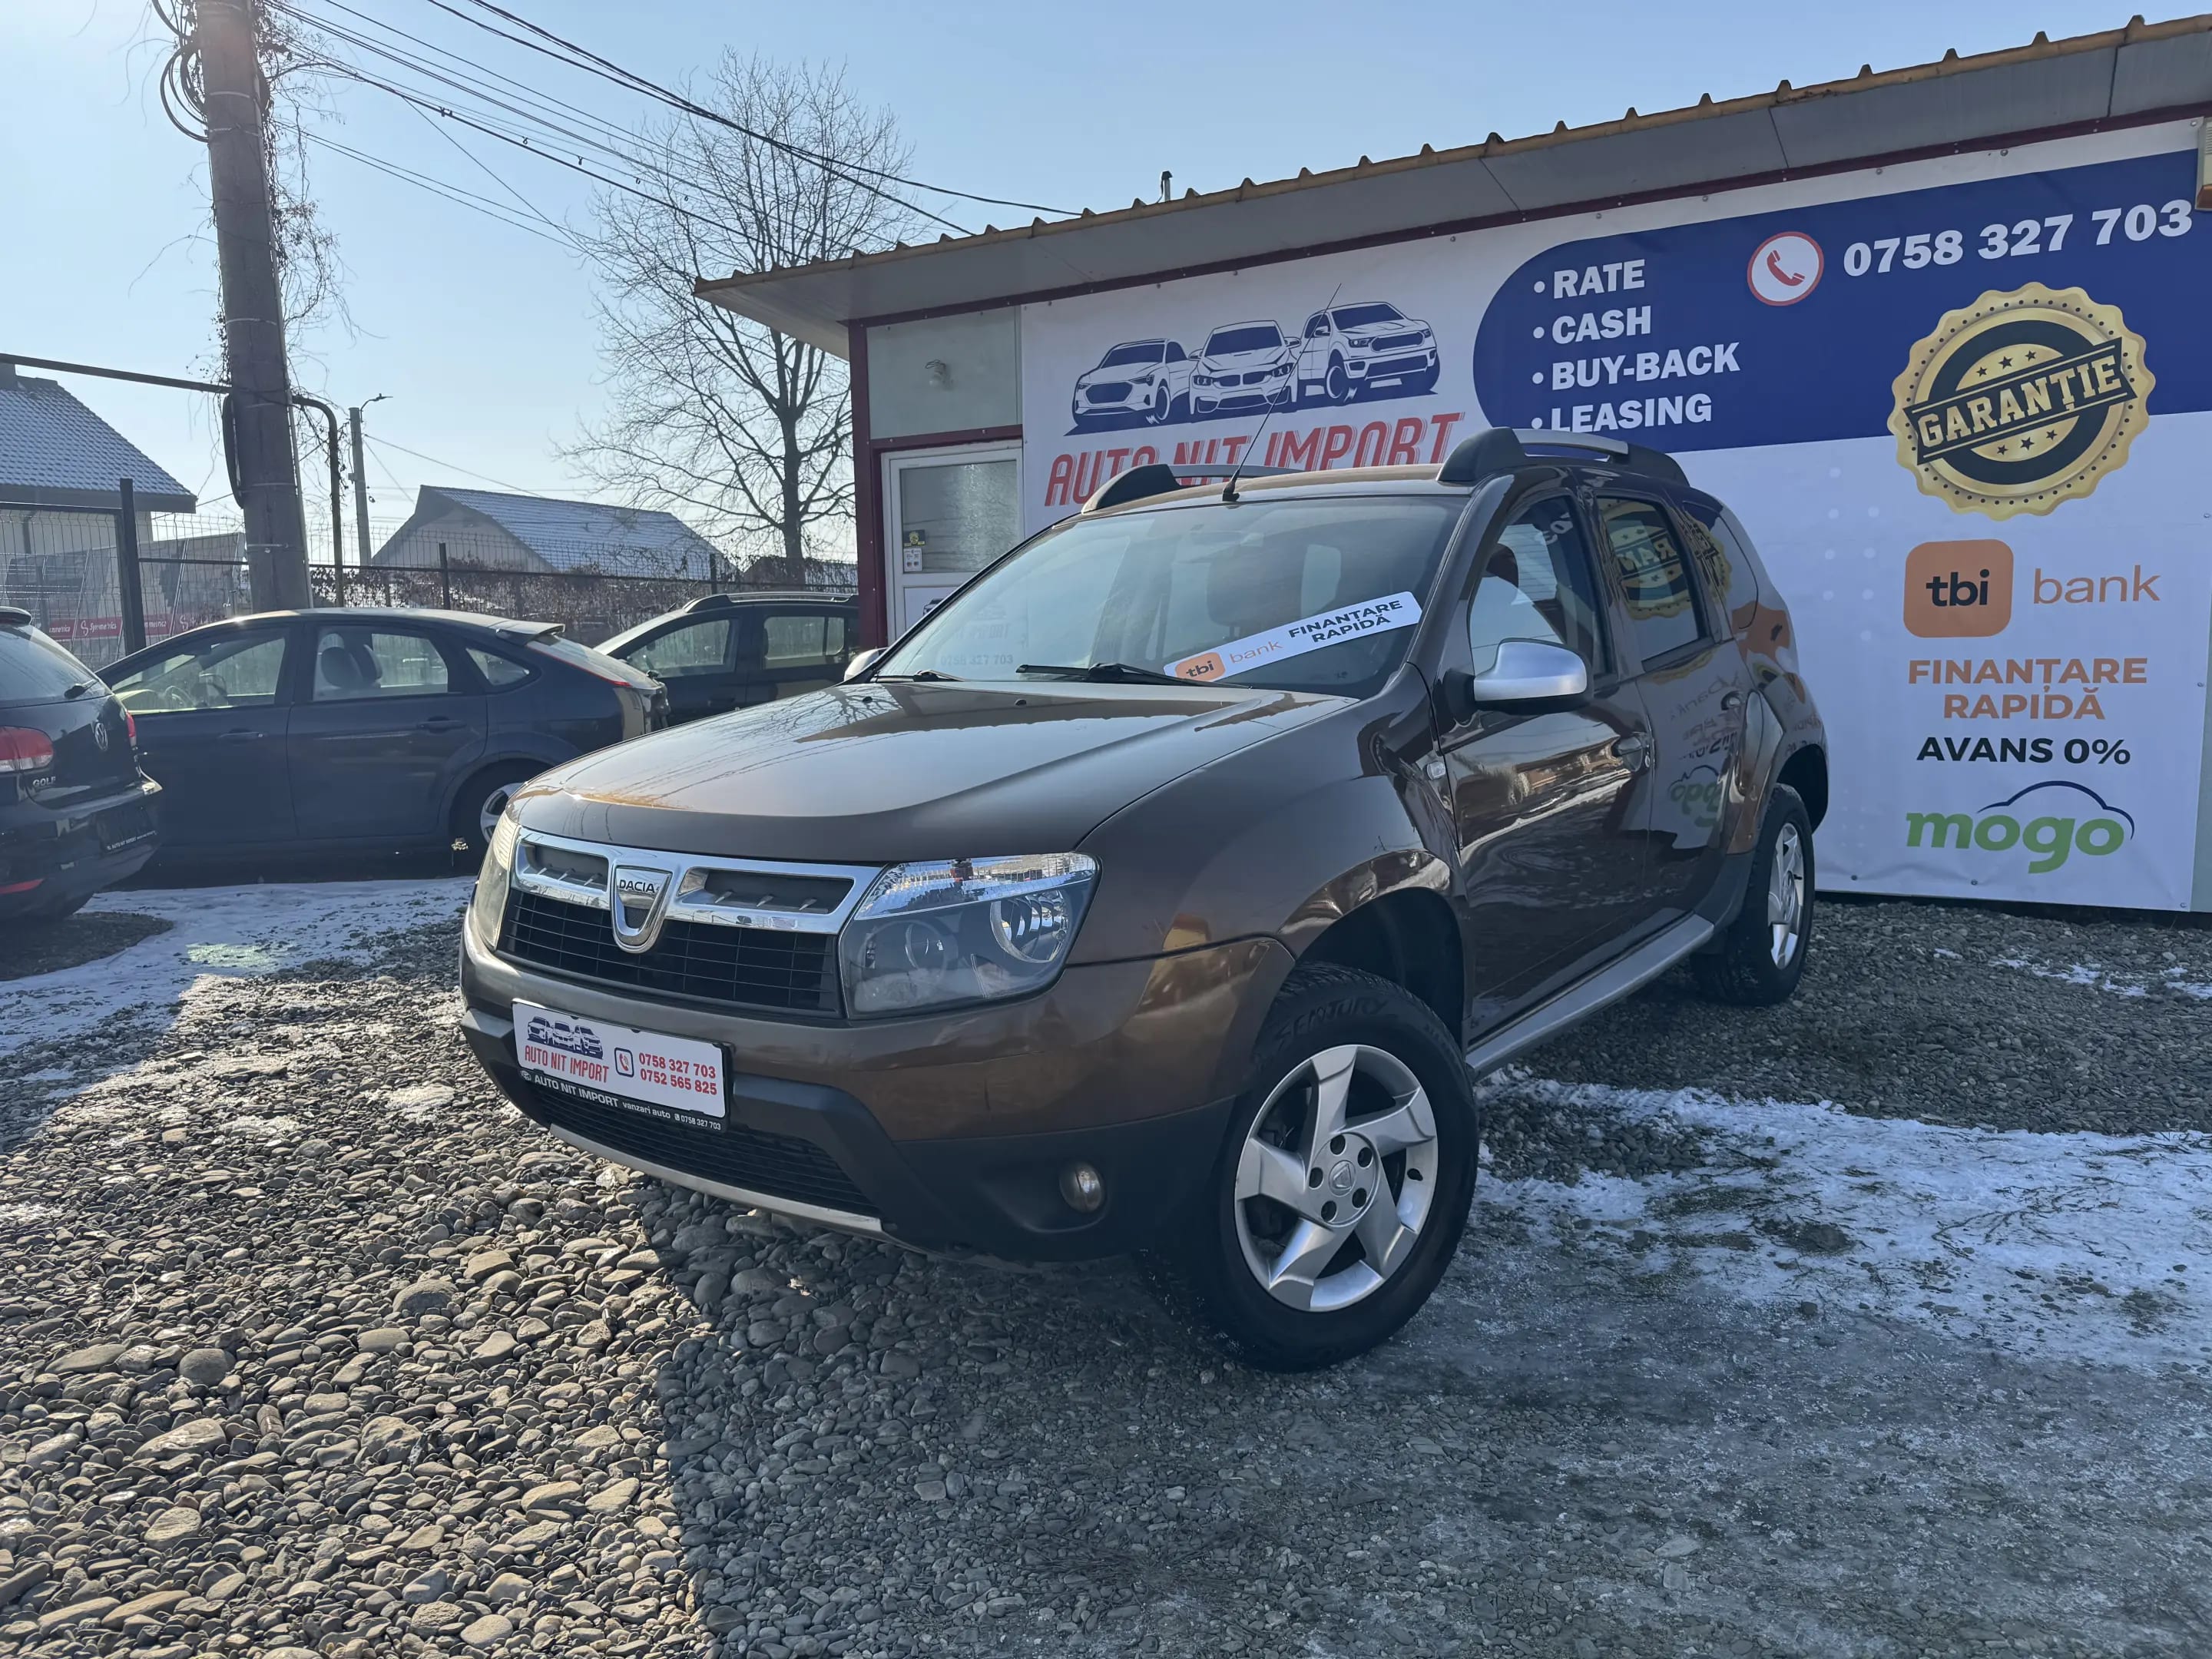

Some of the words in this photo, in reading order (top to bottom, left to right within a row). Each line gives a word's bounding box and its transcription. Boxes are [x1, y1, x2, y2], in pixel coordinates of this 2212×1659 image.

[1843, 230, 1963, 276] 0758
[1978, 214, 2073, 260] 327
[2091, 199, 2193, 246] 703
[1553, 259, 1645, 299] RATE
[1551, 306, 1651, 344] CASH
[1551, 343, 1740, 390] BUY-BACK
[1551, 393, 1712, 433] LEASING
[1264, 412, 1465, 470] IMPORT
[1926, 568, 1990, 607] tbi
[2033, 565, 2161, 604] bank
[1312, 614, 1391, 643] RAPIDĂ
[1186, 661, 1215, 677] tbi
[1229, 640, 1283, 664] bank
[1943, 687, 2106, 720] RAPIDĂ
[1916, 737, 2053, 763] AVANS
[2064, 738, 2131, 765] 0%
[32, 776, 56, 787] GOLF
[1906, 812, 2124, 874] mogo
[619, 879, 655, 893] DACIA
[525, 1045, 548, 1067] AUTO
[551, 1049, 567, 1072] NIT
[570, 1057, 610, 1084] IMPORT
[638, 1052, 666, 1069] 0758
[668, 1058, 689, 1075] 327
[693, 1063, 716, 1079] 703
[640, 1068, 667, 1085] 0752
[670, 1075, 692, 1091] 565
[694, 1080, 717, 1095] 825
[534, 1075, 559, 1091] AUTO
[561, 1081, 577, 1096] NIT
[578, 1087, 619, 1108] IMPORT
[622, 1101, 651, 1114] vanzari
[651, 1108, 671, 1120] auto
[680, 1114, 696, 1125] 0758
[697, 1118, 708, 1128] 327
[709, 1121, 721, 1131] 703
